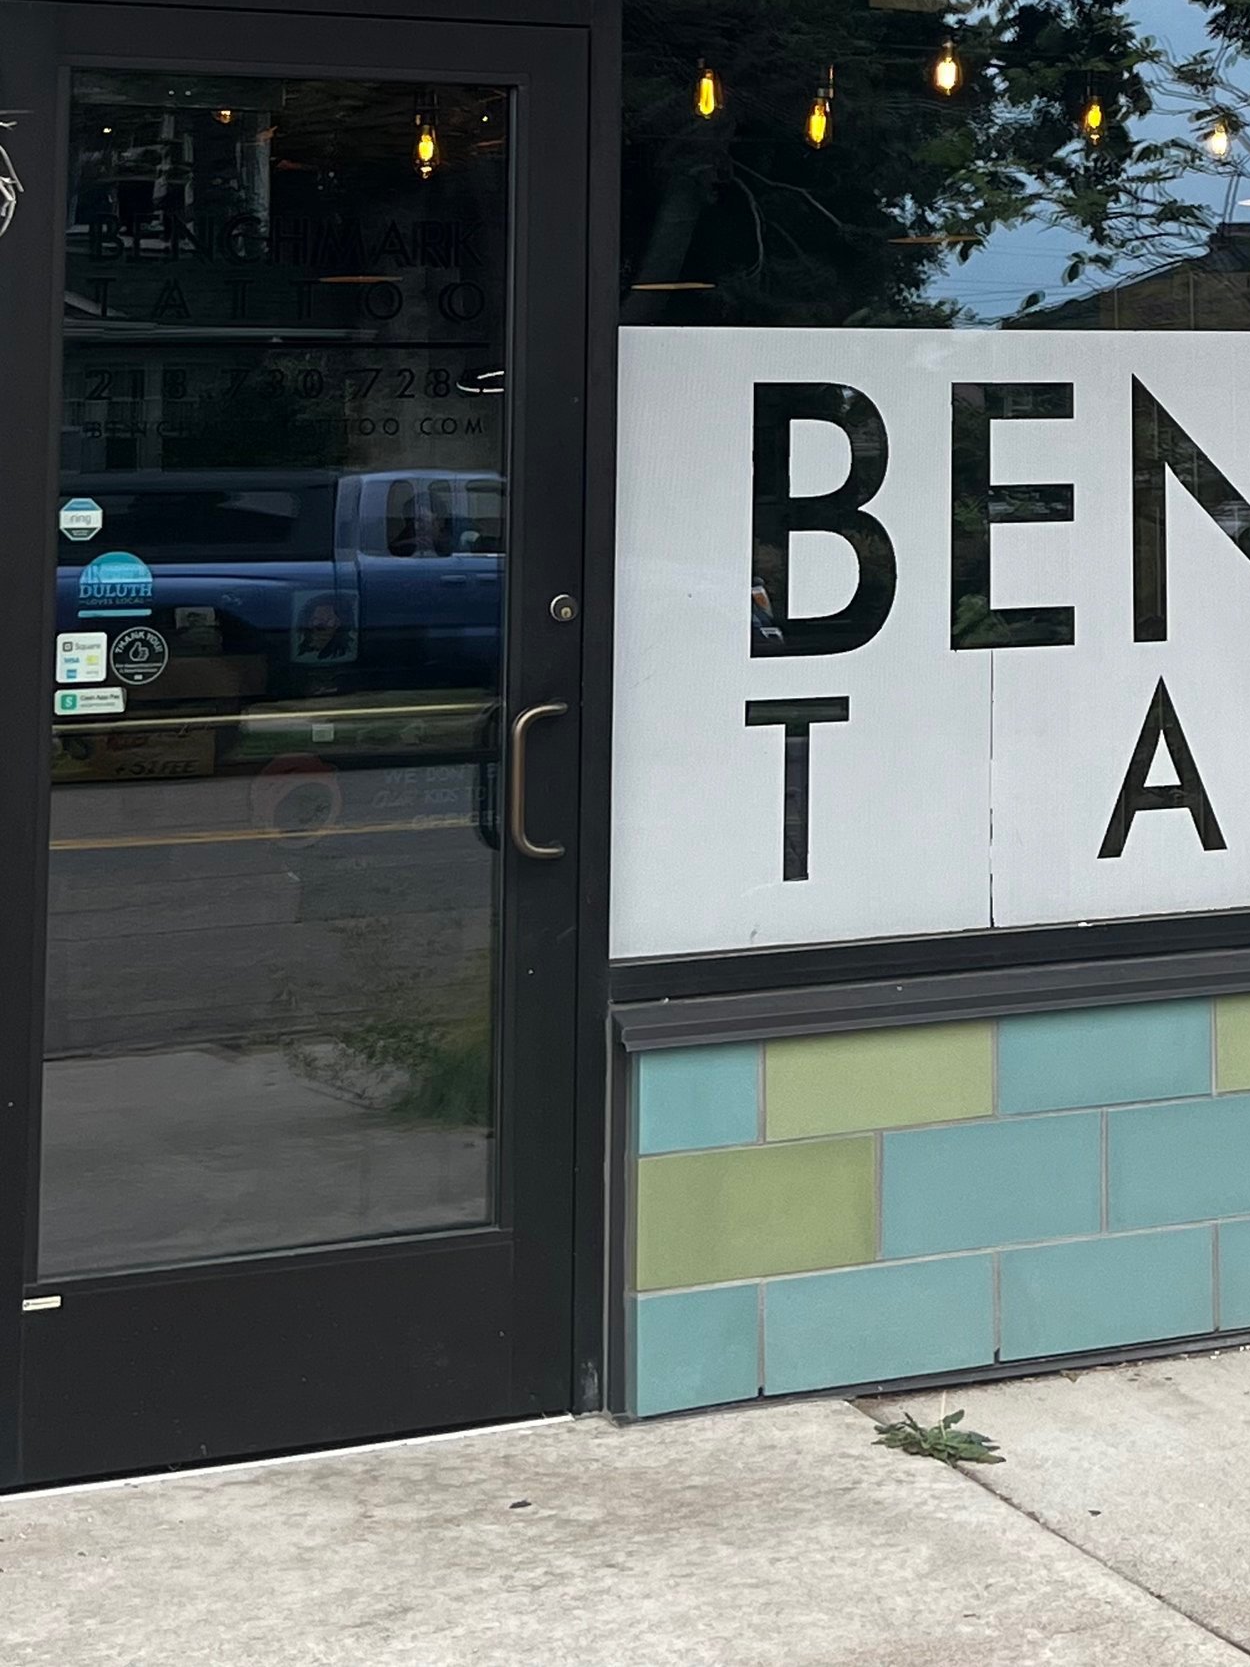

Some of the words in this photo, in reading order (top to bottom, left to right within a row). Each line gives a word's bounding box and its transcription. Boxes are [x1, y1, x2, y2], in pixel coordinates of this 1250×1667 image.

[88, 214, 484, 266] BENCHMARK
[89, 276, 485, 321] TATTOO
[70, 514, 92, 525] ring
[79, 583, 153, 598] DULUTH
[115, 596, 145, 605] LOCAL
[75, 642, 101, 652] Square
[115, 631, 146, 654] THANK
